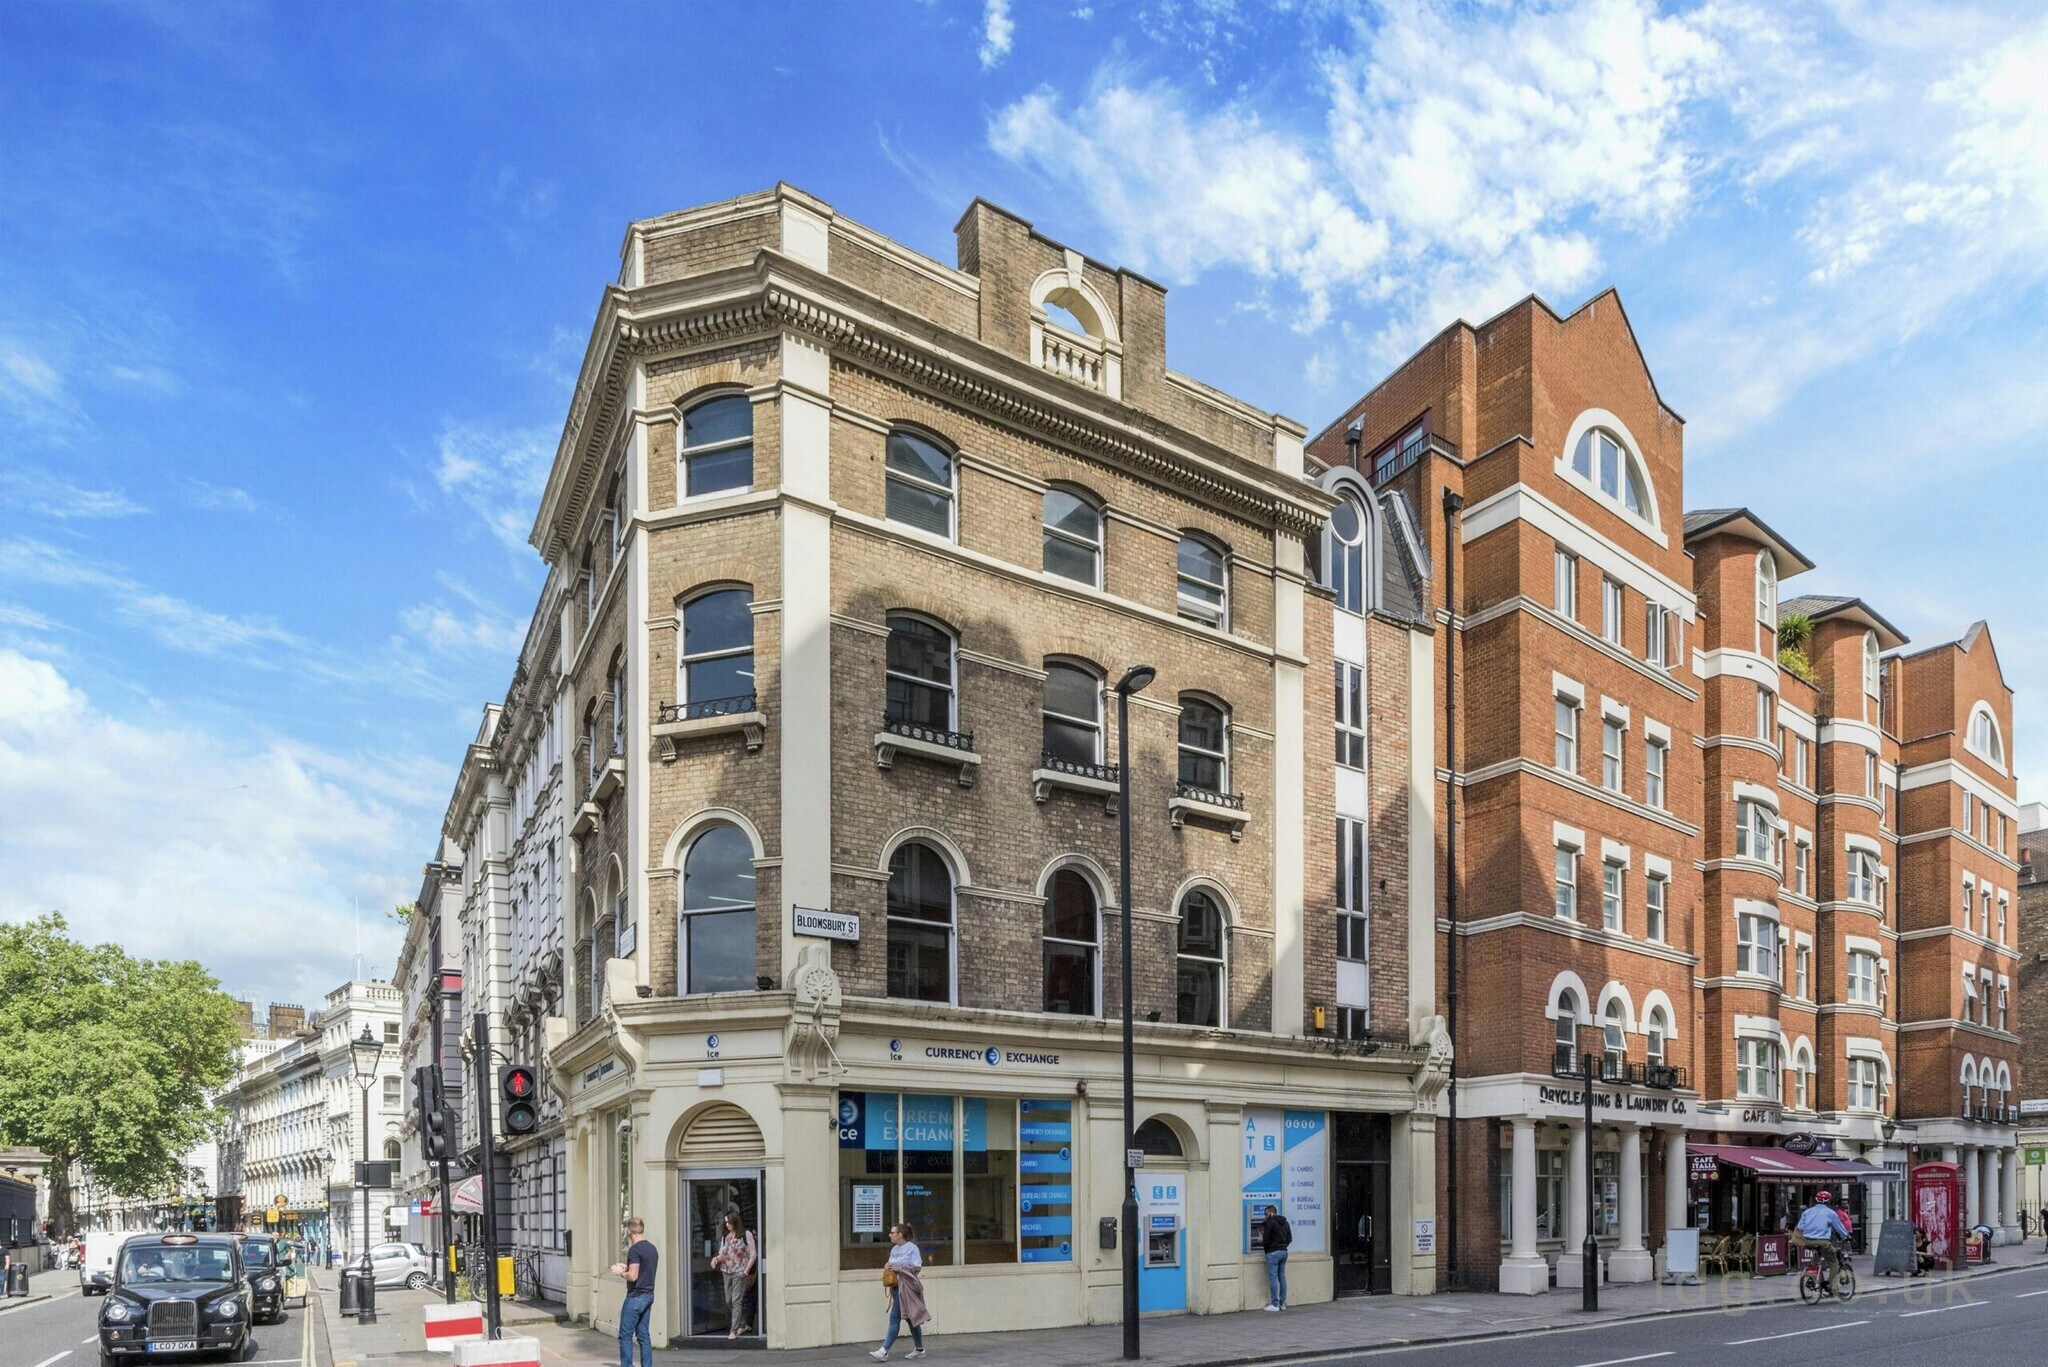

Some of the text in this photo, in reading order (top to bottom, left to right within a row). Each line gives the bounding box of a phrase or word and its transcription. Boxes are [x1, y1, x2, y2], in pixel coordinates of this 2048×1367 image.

[797, 914, 847, 932] BLOOMSBURY
[707, 1050, 719, 1058] ice
[890, 1052, 902, 1061] ice
[925, 1046, 1060, 1065] CURRENCY EXCHANGE
[1614, 1093, 1623, 1109] &
[1626, 1093, 1668, 1113] LAUNDRY
[839, 1128, 858, 1140] ce
[154, 1342, 176, 1350] LC07
